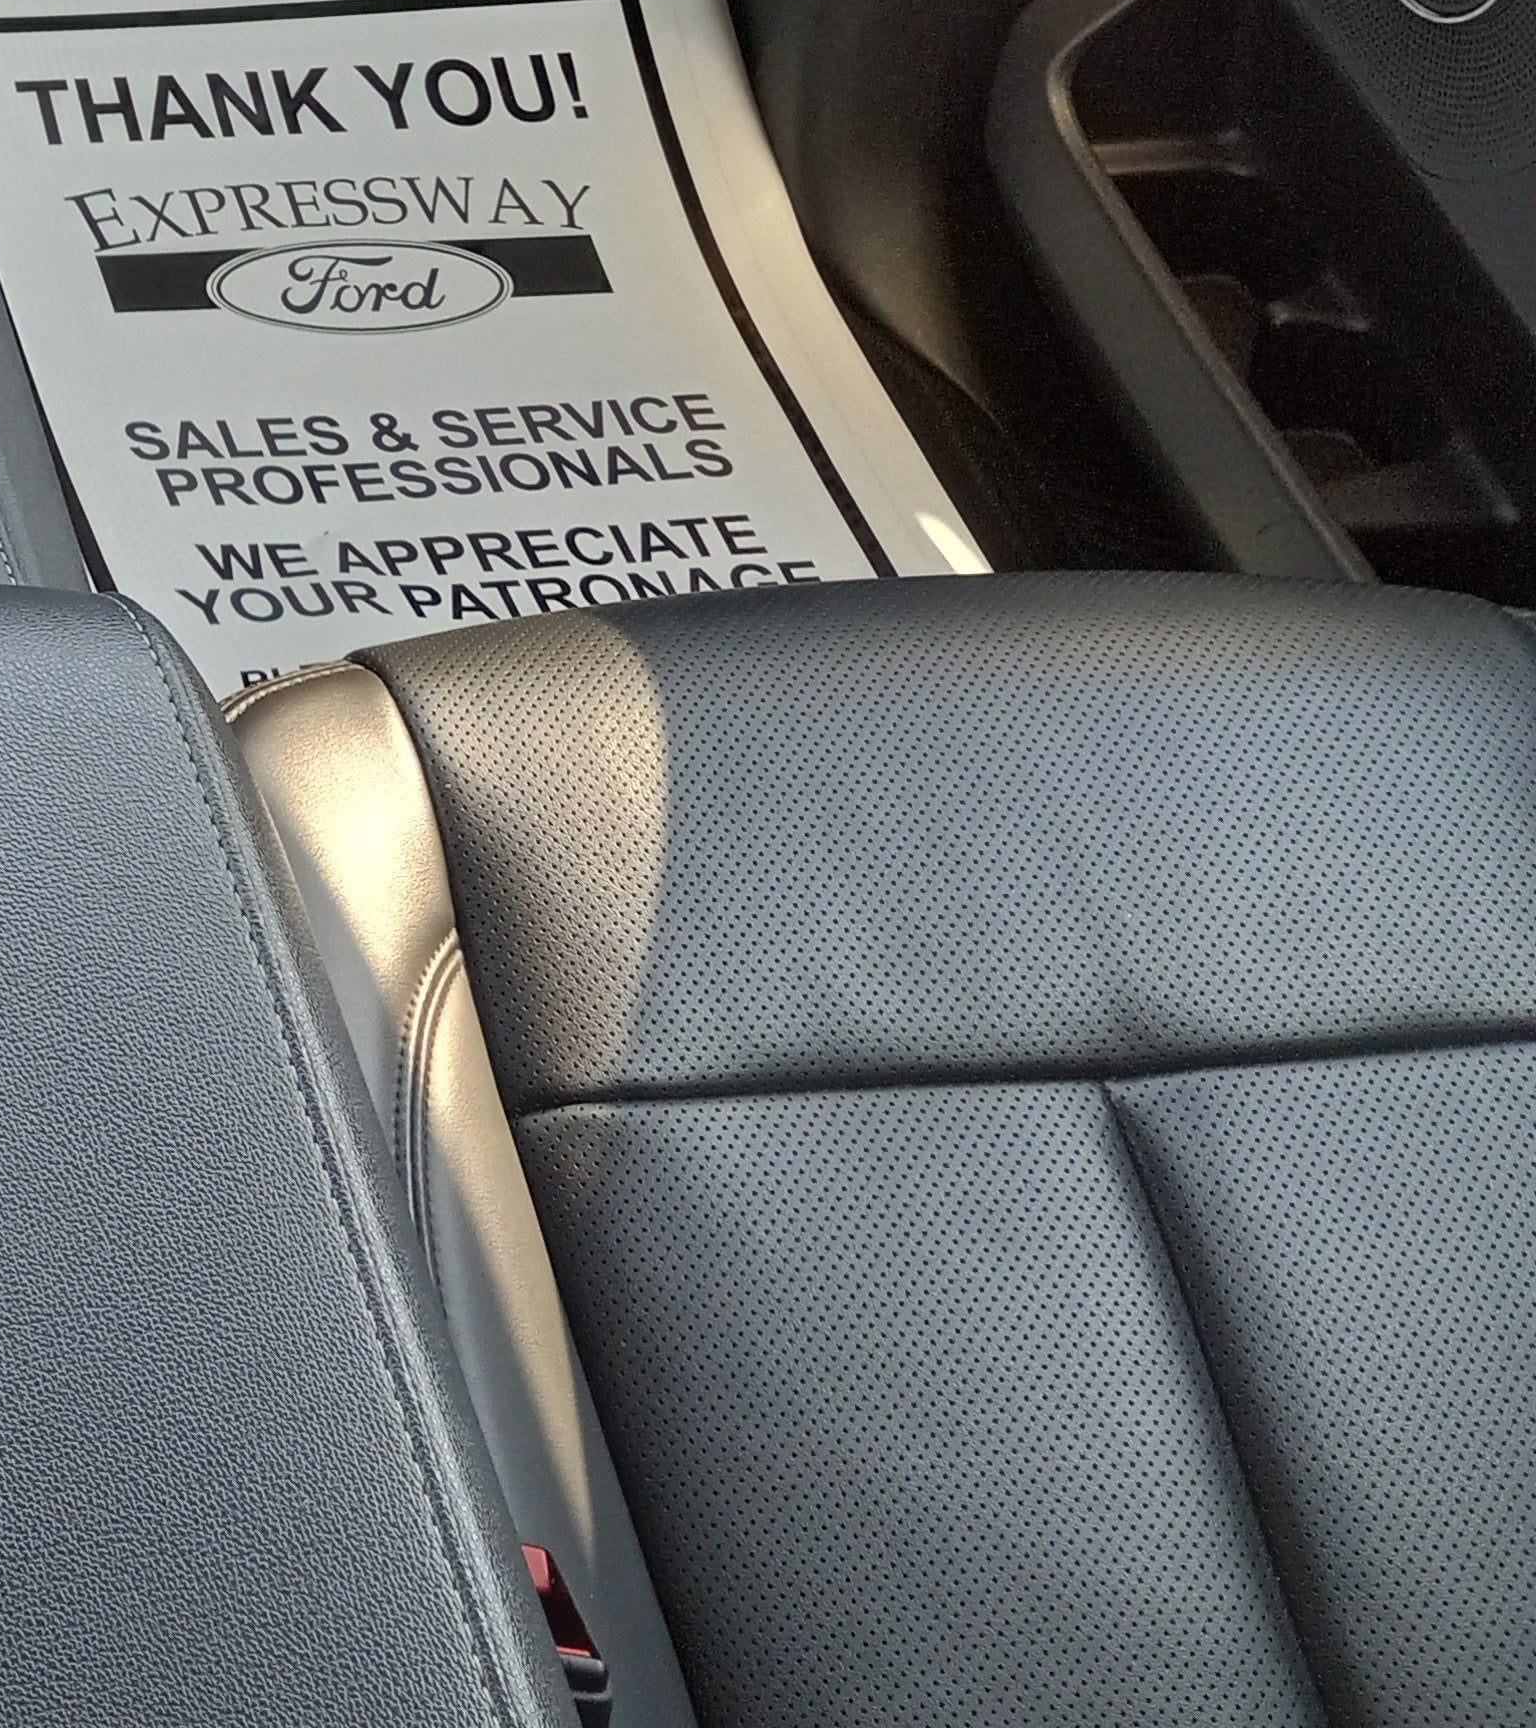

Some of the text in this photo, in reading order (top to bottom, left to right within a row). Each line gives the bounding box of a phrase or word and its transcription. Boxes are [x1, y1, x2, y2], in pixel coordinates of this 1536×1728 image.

[14, 52, 591, 146] THANK YOU!
[64, 175, 592, 253] EXPRESSWAY
[280, 253, 446, 315] Ford
[123, 392, 727, 463] SALES & SERVICE
[153, 437, 735, 508] PROFESSIONALS
[194, 514, 769, 581] WE APPRECIATE
[174, 579, 395, 626] YOUR
